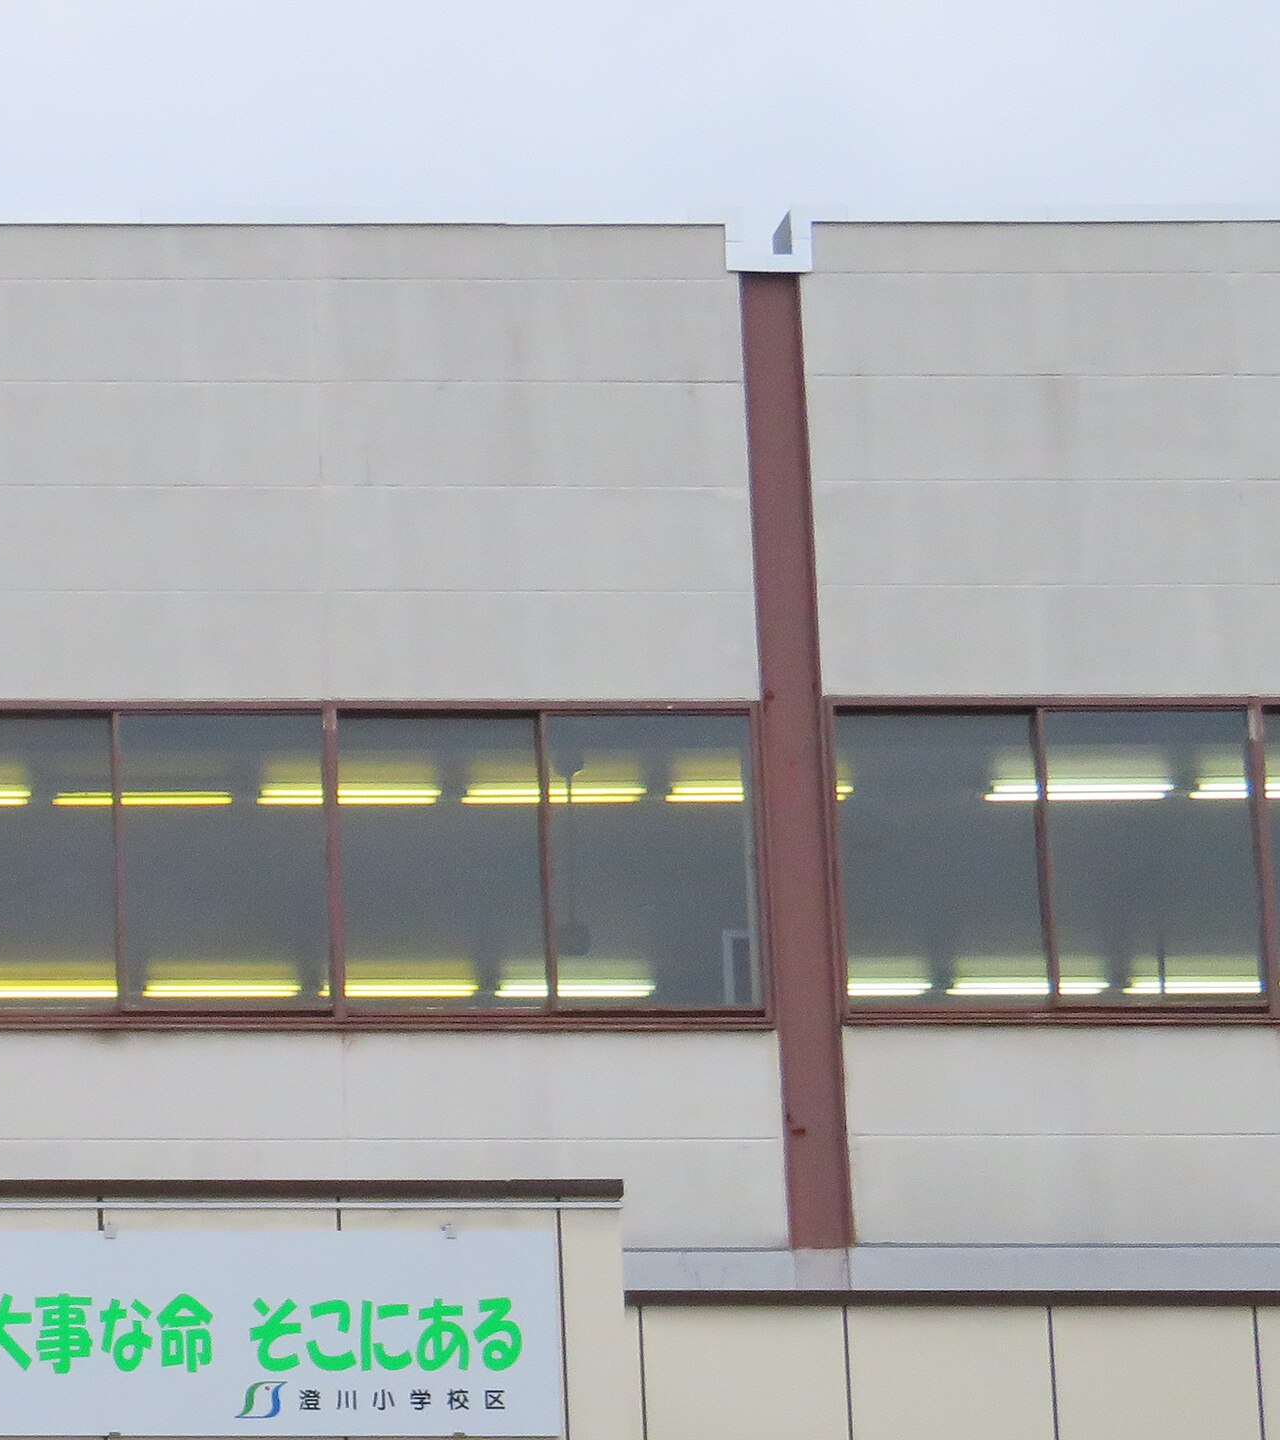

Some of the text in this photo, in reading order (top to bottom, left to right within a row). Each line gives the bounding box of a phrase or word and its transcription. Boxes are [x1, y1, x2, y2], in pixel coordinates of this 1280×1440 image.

[250, 1297, 522, 1372] そこにある
[298, 1388, 506, 1411] 澄川小学校区
